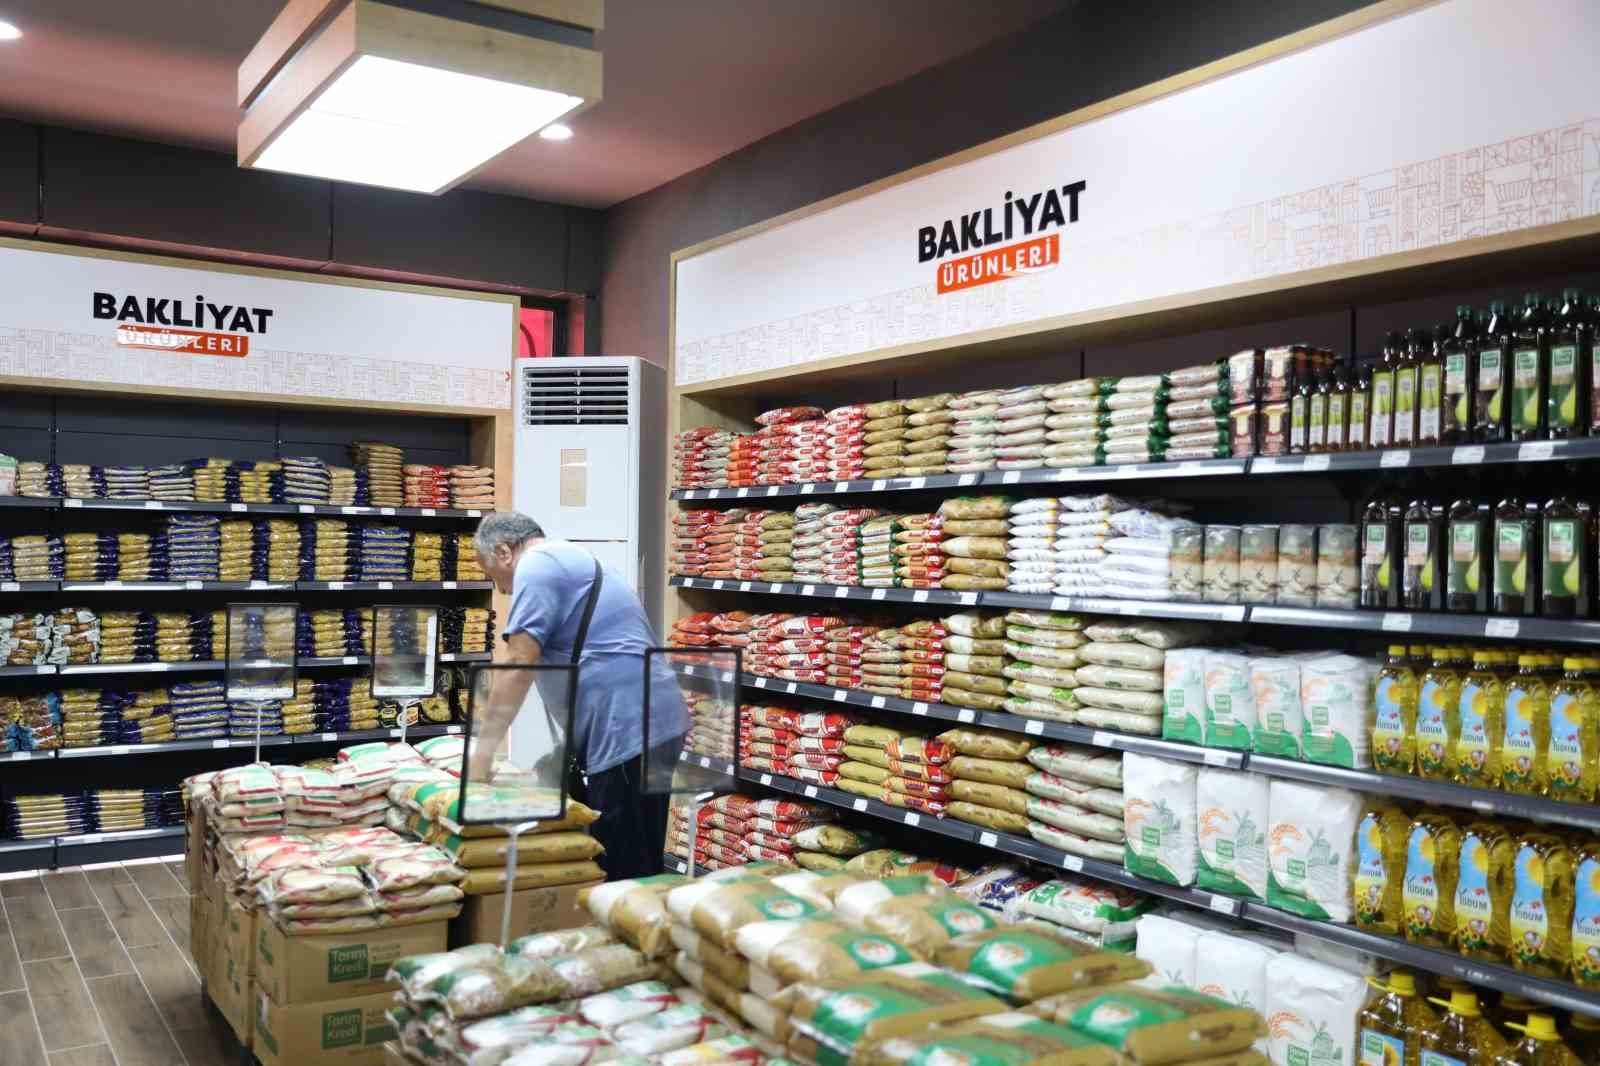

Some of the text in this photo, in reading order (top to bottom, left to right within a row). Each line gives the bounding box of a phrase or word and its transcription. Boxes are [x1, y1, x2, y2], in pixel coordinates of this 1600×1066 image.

[918, 180, 1086, 263] BAKLİYAT
[942, 239, 1051, 286] ÜRÜNLERİ
[93, 292, 273, 334] BAKLİYAT
[125, 326, 241, 352] ÜRÜNLERİ
